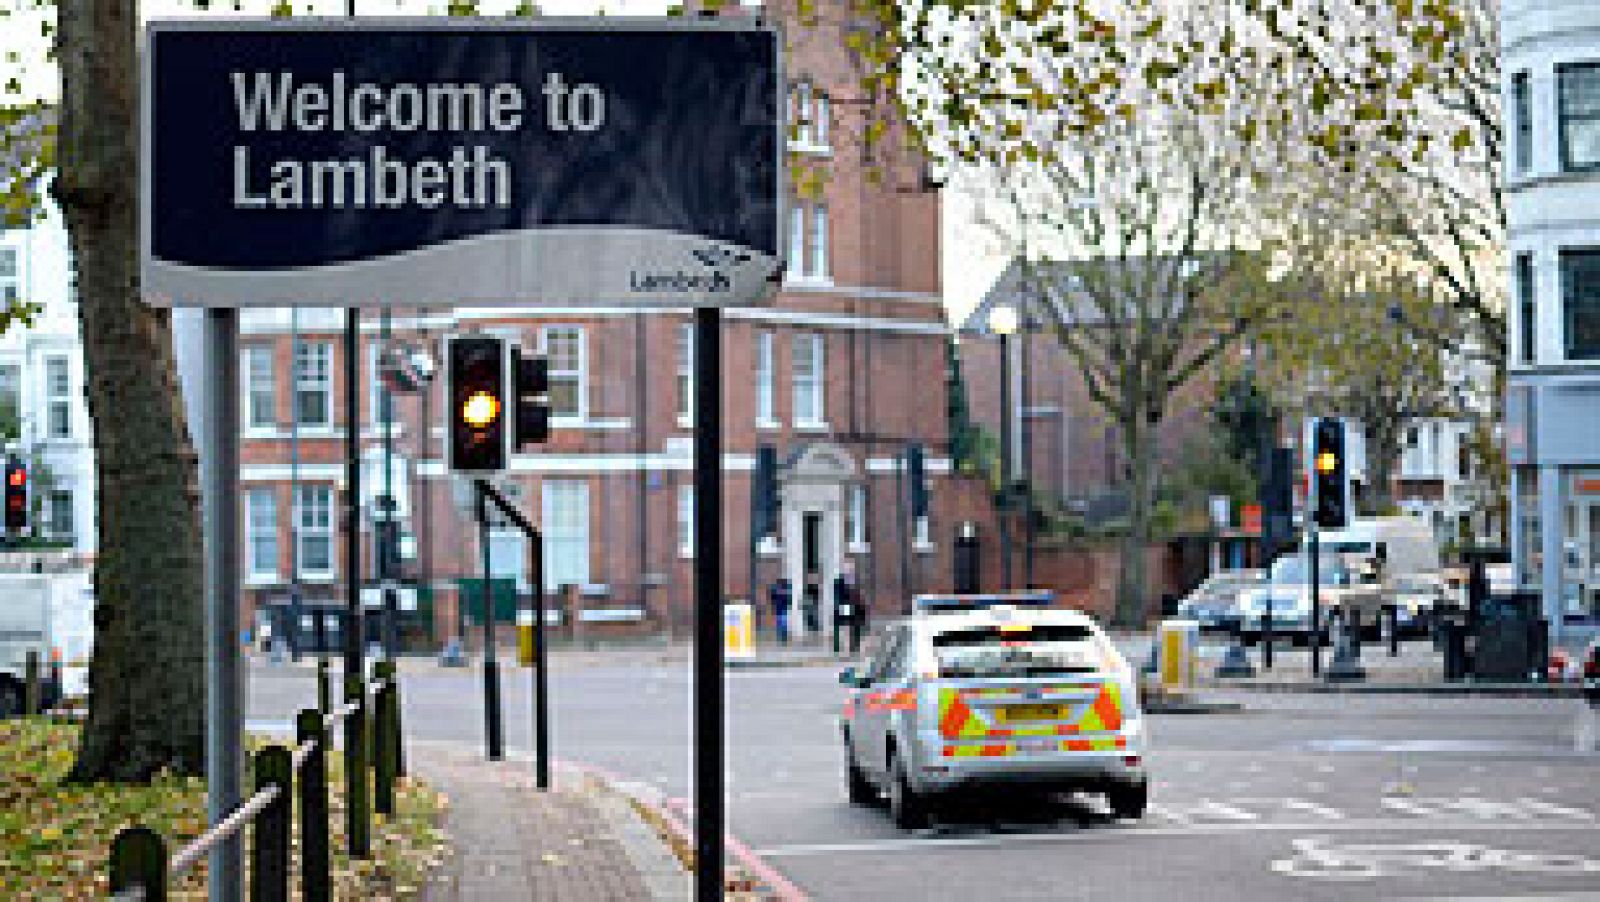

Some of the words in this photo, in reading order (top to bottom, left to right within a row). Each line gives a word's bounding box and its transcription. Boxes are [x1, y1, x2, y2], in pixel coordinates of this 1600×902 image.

[232, 71, 523, 132] Welcome
[542, 71, 607, 132] to
[233, 145, 512, 209] Lambeth
